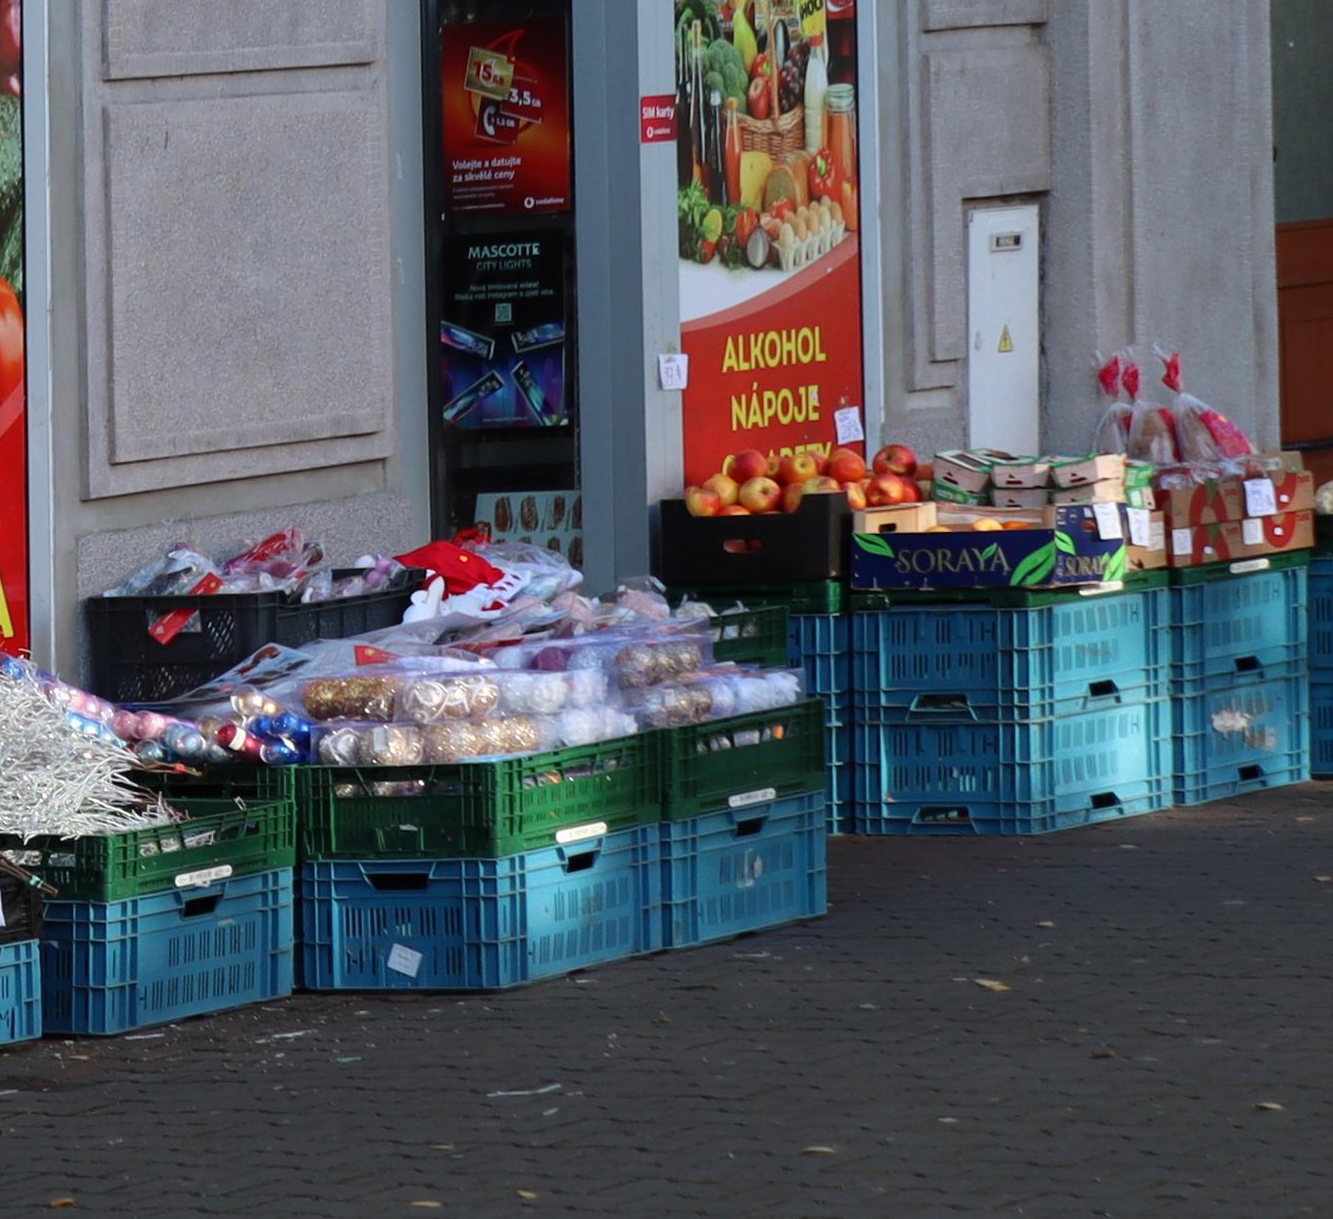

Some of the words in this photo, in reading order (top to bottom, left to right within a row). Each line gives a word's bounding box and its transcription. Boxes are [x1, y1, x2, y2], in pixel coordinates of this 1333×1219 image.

[468, 242, 540, 260] MASCOTTE
[476, 261, 498, 271] CITY
[499, 259, 532, 270] LIGHTS
[722, 326, 826, 373] ALKOHOL
[731, 382, 820, 431] NÁPOJE
[897, 546, 1012, 576] SORAYA
